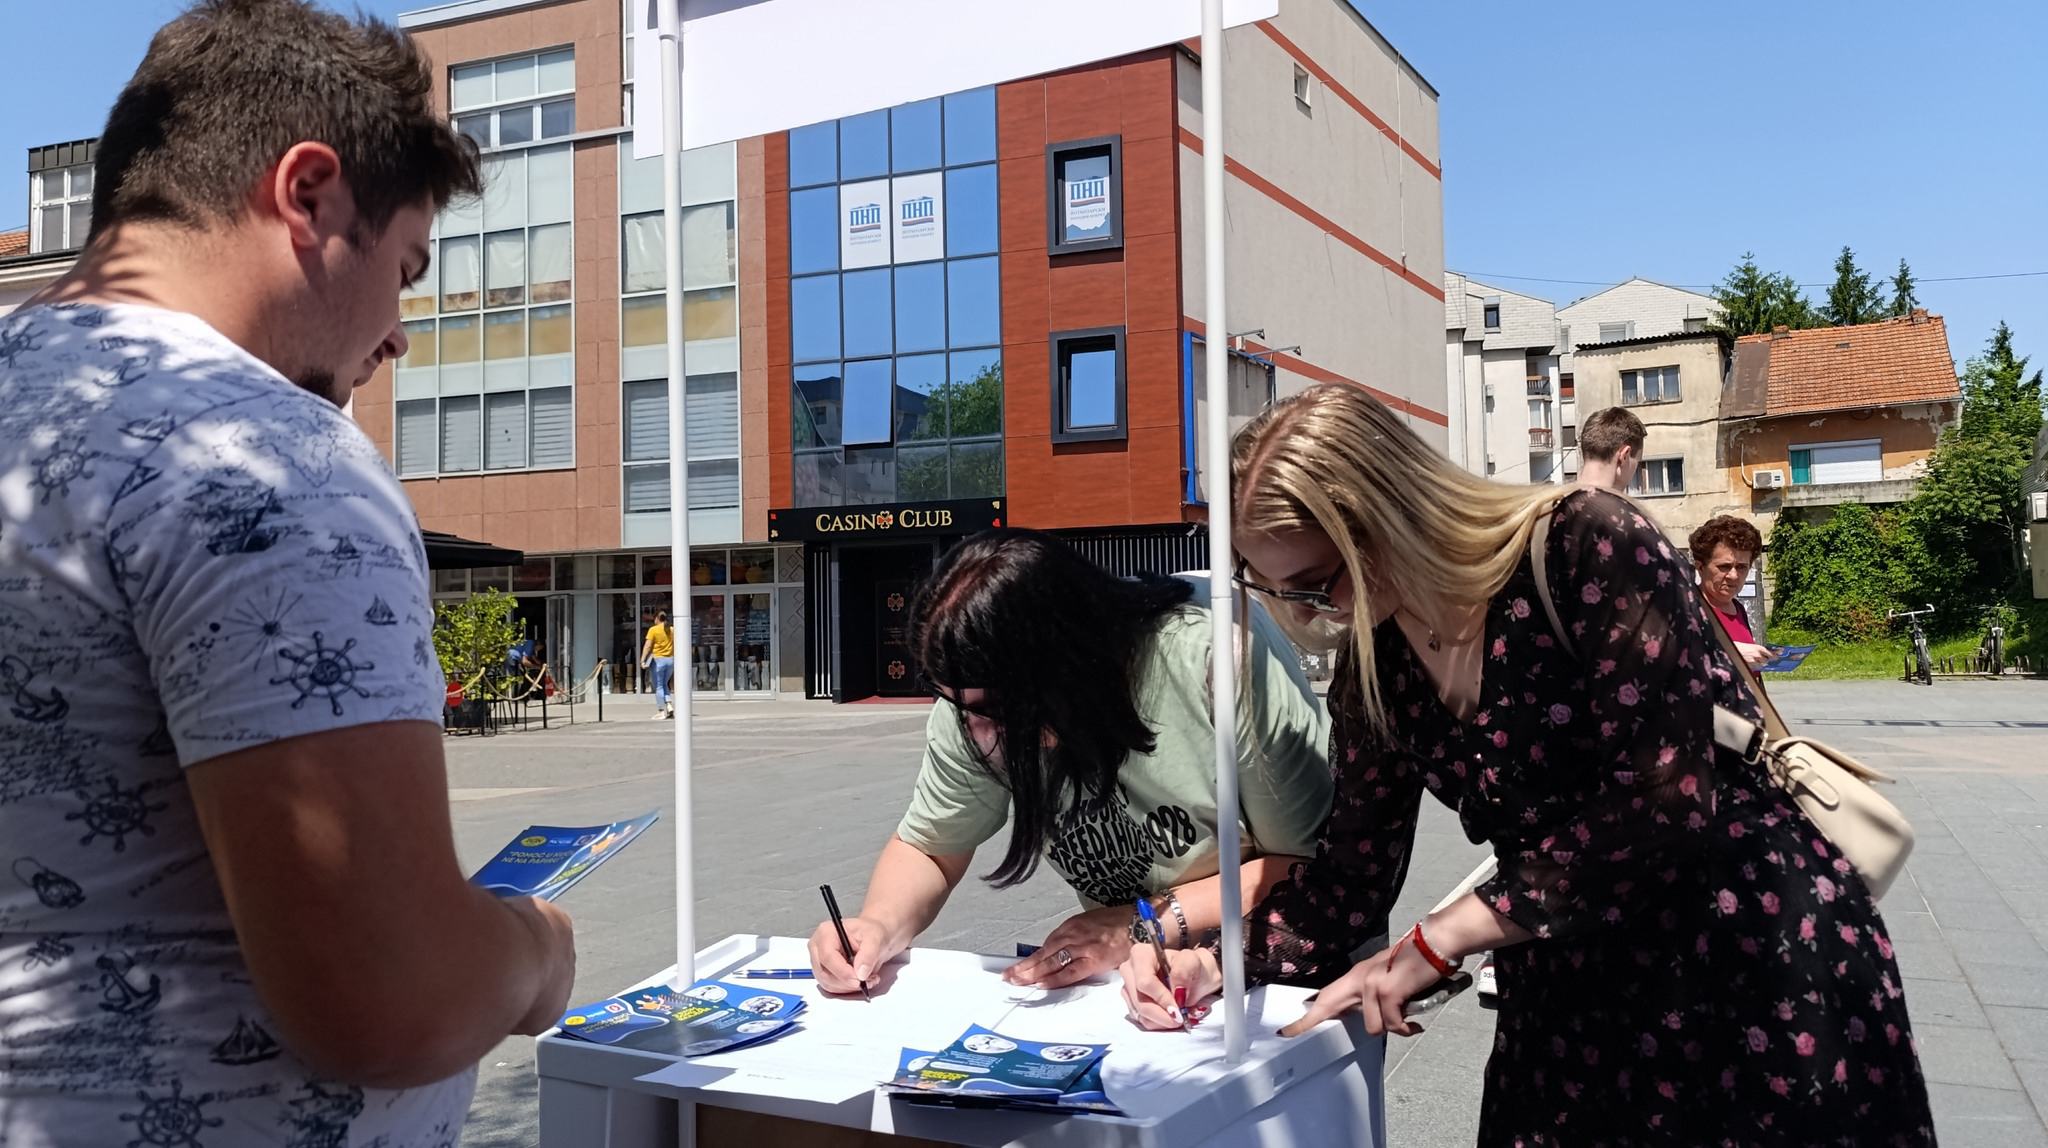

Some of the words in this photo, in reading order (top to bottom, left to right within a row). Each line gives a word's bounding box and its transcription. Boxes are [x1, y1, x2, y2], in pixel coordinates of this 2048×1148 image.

[1070, 180, 1105, 200] ПНП
[850, 208, 881, 227] ПНП
[902, 200, 934, 220] ПНП
[899, 509, 953, 529] CLUB
